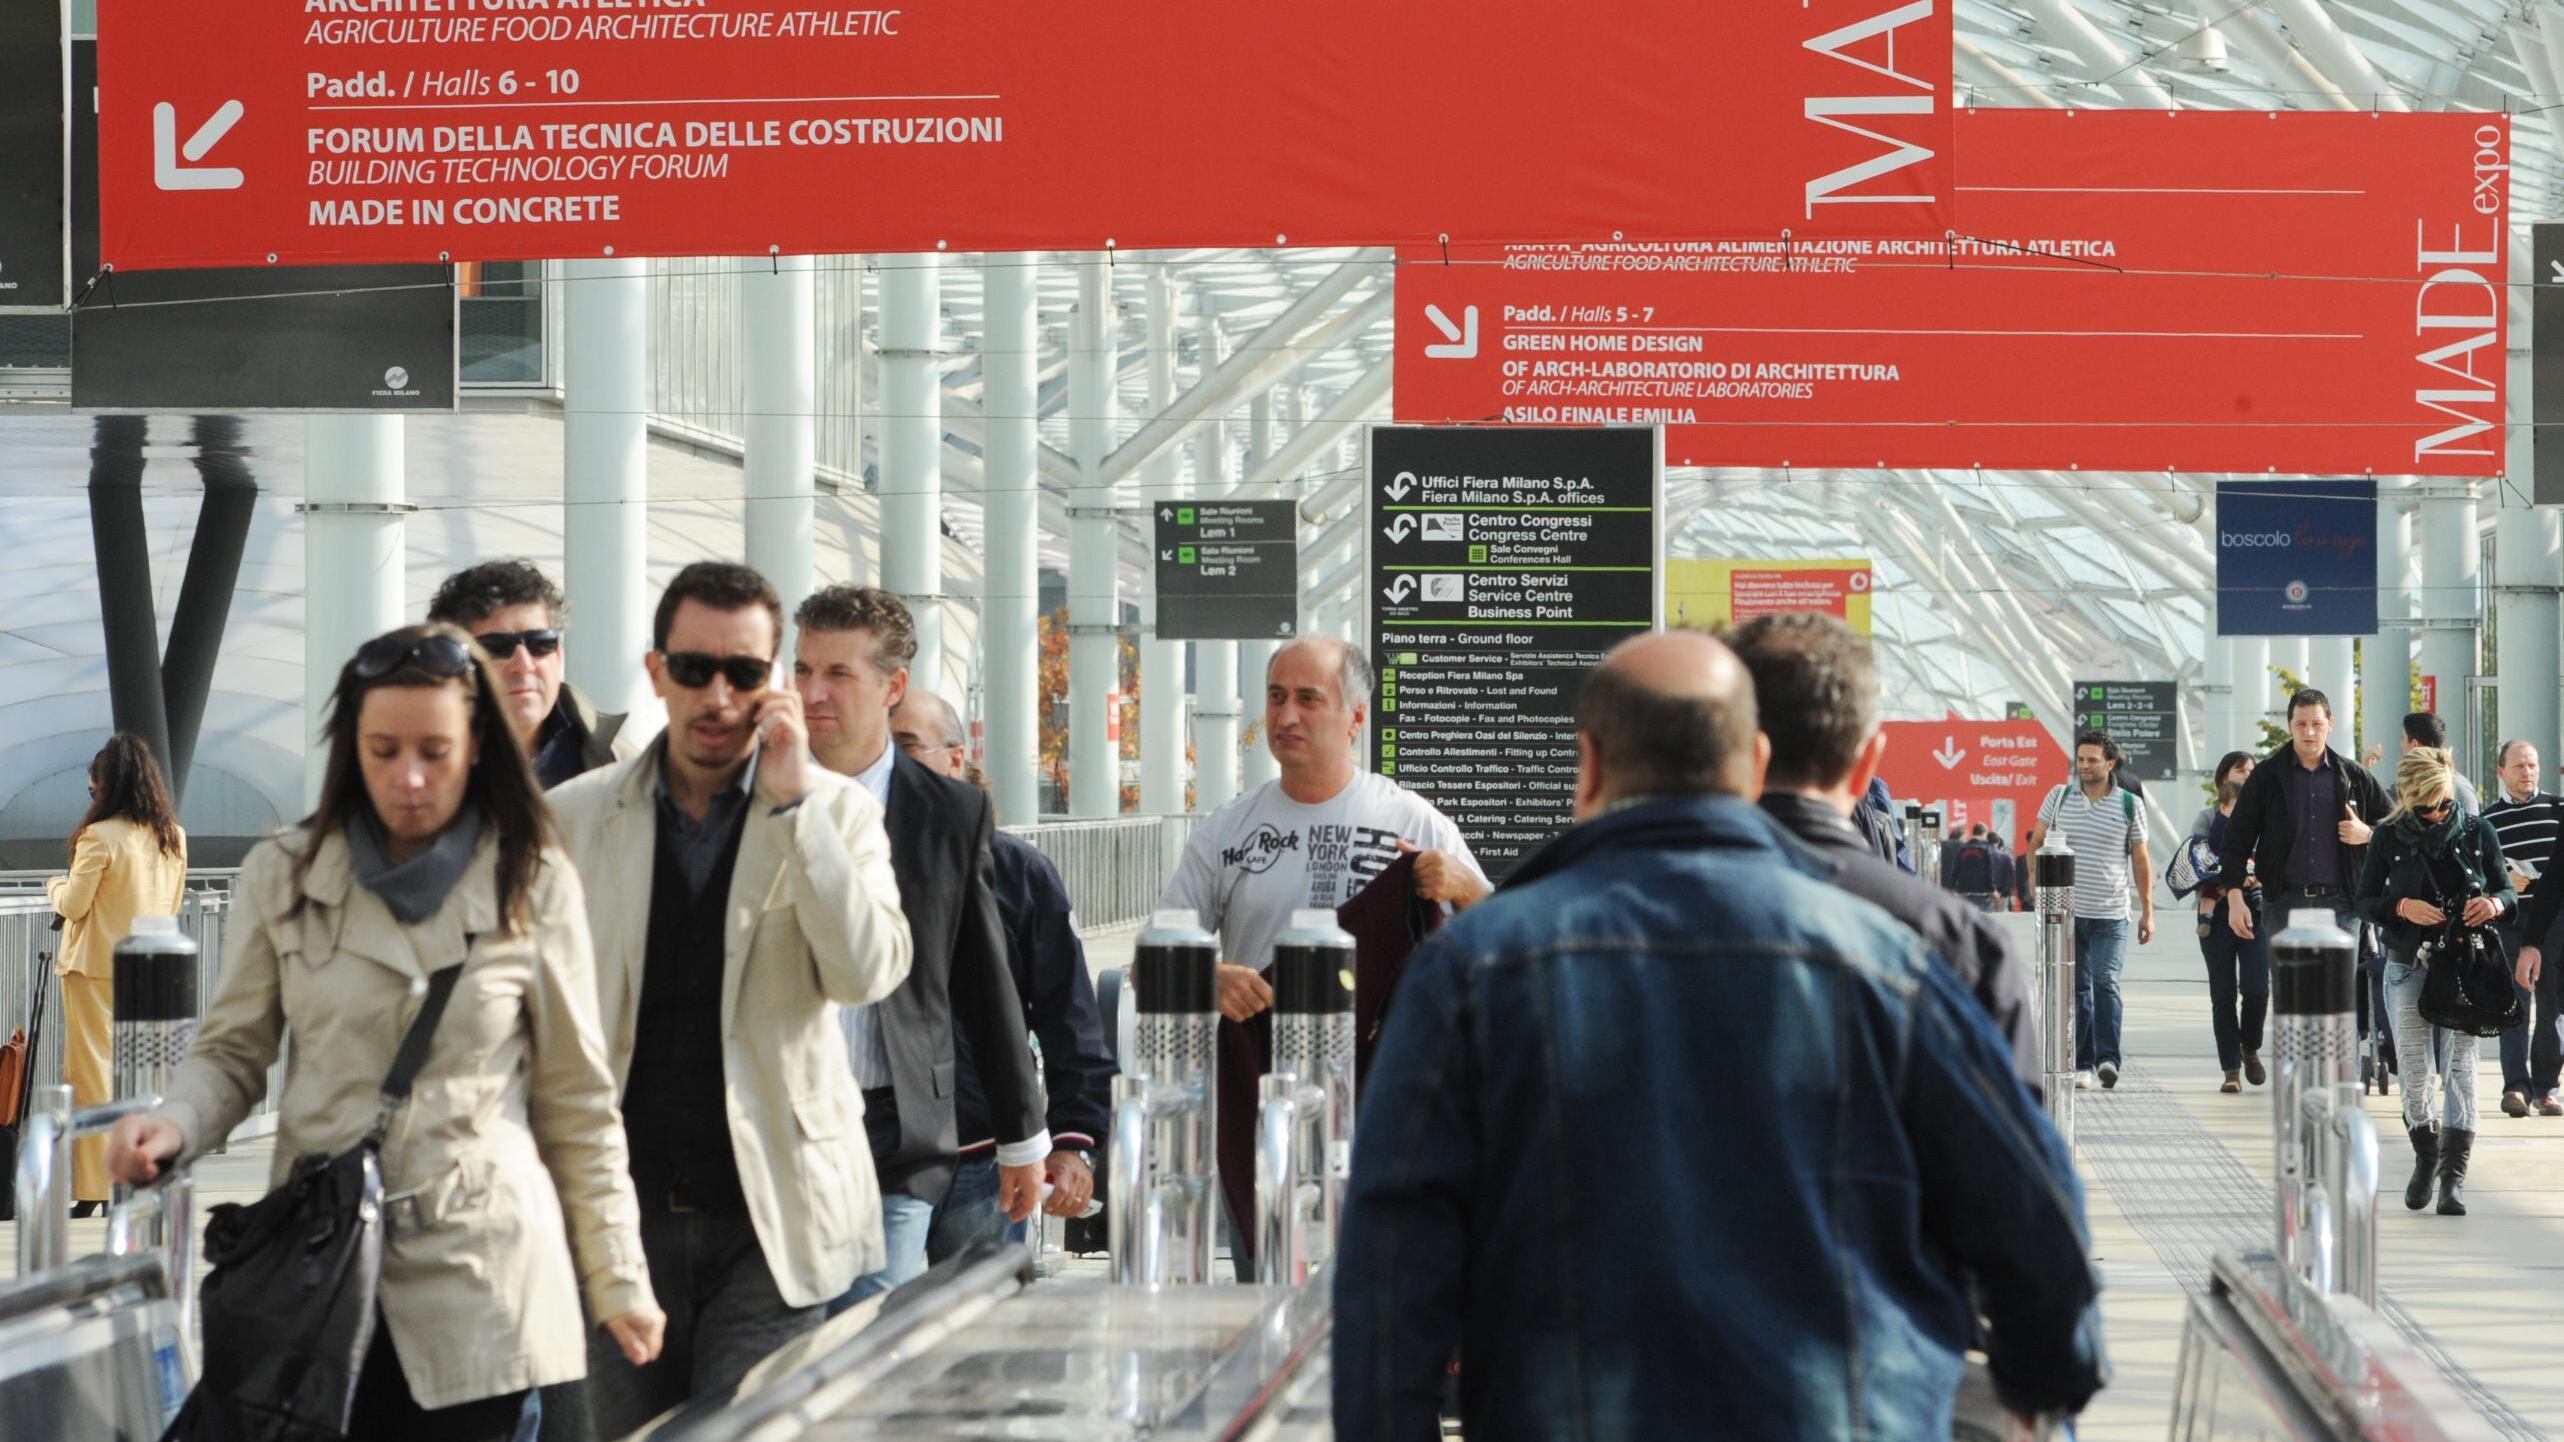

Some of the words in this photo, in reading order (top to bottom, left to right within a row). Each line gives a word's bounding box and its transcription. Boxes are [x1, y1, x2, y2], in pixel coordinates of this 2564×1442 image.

[304, 17, 487, 44] AGRICULTURE
[491, 16, 571, 41] FOOD
[575, 13, 774, 40] ARCHITECTURE
[777, 10, 901, 37] ATHLETIC
[307, 71, 396, 98] Padd.
[403, 71, 414, 98] /
[422, 69, 490, 96] Halls
[498, 70, 518, 94] 6
[545, 69, 580, 94] 10
[1802, 0, 1935, 219] MA
[307, 128, 425, 153] FORUM
[433, 125, 534, 151] DELLA
[541, 122, 677, 149] TECNICA
[686, 121, 781, 147] DELLE
[788, 117, 1003, 145] COSTRUZIONI
[308, 159, 436, 185] BUILDING
[442, 155, 627, 184] TECHNOLOGY
[630, 153, 729, 180] FORUM
[2473, 125, 2509, 215] expo
[308, 199, 403, 226] MADE
[412, 199, 445, 225] IN
[453, 195, 621, 223] CONCRETE
[1876, 240, 2024, 256] ARCHITETTURA
[2026, 240, 2116, 257] ATLETICA
[1503, 254, 1611, 271] AGRICULTURE
[1613, 255, 1662, 271] FOOD
[1663, 255, 1782, 272] ARCHITECTURE
[1783, 257, 1857, 273] ATHLETIC
[1504, 305, 1557, 322] Padd.
[1570, 306, 1612, 322] Halls
[1616, 307, 1627, 322] 5
[1643, 307, 1654, 322] 7
[1503, 335, 1565, 352] GREEN
[1570, 335, 1627, 352] HOME
[1631, 335, 1703, 353] DESIGN
[2415, 217, 2499, 463] MADE
[1503, 361, 1528, 377] OF
[1533, 361, 1727, 379] ARCH-LABORATORIO
[1755, 363, 1900, 380] ARCHITETTURA
[1502, 379, 1526, 396] OF
[1526, 380, 1694, 397] ARCH-ARCHITECTURE
[1696, 382, 1814, 399] LABORATORIES
[1503, 406, 1557, 423] ASILO
[1561, 407, 1628, 424] FINALE
[1632, 407, 1697, 424] EMILIA
[1421, 476, 1459, 488] Uffici
[1463, 476, 1499, 489] Fiera
[1502, 477, 1550, 489] Milano
[1553, 477, 1594, 491] S.p.A.
[1421, 490, 1457, 503] Fiera
[1461, 491, 1509, 503] Milano
[1513, 491, 1554, 506] S.p.A.
[1558, 491, 1605, 504] offices
[1468, 514, 1517, 527] Centro
[1520, 514, 1592, 530] Congressi
[1200, 527, 1226, 538] Lem
[1229, 527, 1235, 538] 1
[1468, 529, 1537, 545] Congress
[1540, 529, 1588, 542] Centre
[2221, 530, 2291, 547] boscolo
[1490, 544, 1512, 554] Sale
[1513, 544, 1559, 556] Convegni
[1552, 555, 1571, 564] Hall
[1200, 565, 1226, 576] Lem
[1228, 565, 1237, 576] 2
[1468, 574, 1517, 587] Centro
[1520, 574, 1568, 587] Servizi
[1468, 589, 1521, 602] Service
[1525, 590, 1573, 602] Centre
[1468, 606, 1532, 619] Business
[1536, 606, 1573, 619] Point
[1382, 633, 1416, 643] Piano
[1419, 633, 1447, 644] terra
[1458, 633, 1502, 644] Ground
[1505, 633, 1534, 644] floor
[1421, 654, 1466, 663] Customer
[1468, 654, 1502, 663] Service
[1400, 671, 1445, 681] Reception
[1447, 671, 1471, 680] Fiera
[1472, 671, 1503, 680] Milano
[1505, 671, 1524, 682] Spa
[1400, 686, 1426, 695] Perso
[1436, 686, 1478, 695] Ritrovato
[1487, 686, 1507, 695] Lost
[1509, 687, 1527, 695] and
[1528, 686, 1558, 695] Found
[1400, 701, 1456, 710] Informazioni
[1464, 701, 1517, 710] Information
[1400, 713, 1416, 723] Fax
[1424, 713, 1470, 724] Fotocopie
[1478, 714, 1495, 723] Fax
[1497, 714, 1515, 723] and
[1517, 714, 1575, 725] Photocopies
[1399, 731, 1429, 740] Centro
[1431, 731, 1473, 741] Preghiera
[1475, 731, 1496, 740] Oasi
[1497, 731, 1511, 740] del
[1513, 731, 1548, 740] Silenzio
[1980, 736, 2015, 749] Porta
[1399, 747, 1441, 756] Controllo
[1443, 747, 1498, 756] Allestimenti
[1505, 748, 1533, 758] Fitting
[1536, 749, 1548, 758] up
[1399, 764, 1428, 773] Ufficio
[1430, 764, 1473, 773] Controllo
[1475, 764, 1509, 773] Traffico
[1517, 765, 1545, 773] Traffic
[1399, 781, 1435, 789] Rilascio
[1437, 781, 1473, 789] Tessere
[1475, 781, 1520, 791] Espositori
[1528, 782, 1561, 790] Official
[1437, 798, 1458, 806] Park
[1460, 798, 1507, 807] Espositori
[1515, 798, 1564, 806] Exhibitors'
[1466, 814, 1506, 825] Catering
[1514, 814, 1553, 825] Catering
[1309, 825, 1352, 843] NEW
[1493, 831, 1545, 841] Newspaper
[1259, 830, 1299, 854] Rock
[1308, 844, 1349, 861] YORK
[1480, 848, 1502, 856] First
[1503, 848, 1519, 856] Aid
[1306, 861, 1348, 872] LONDON
